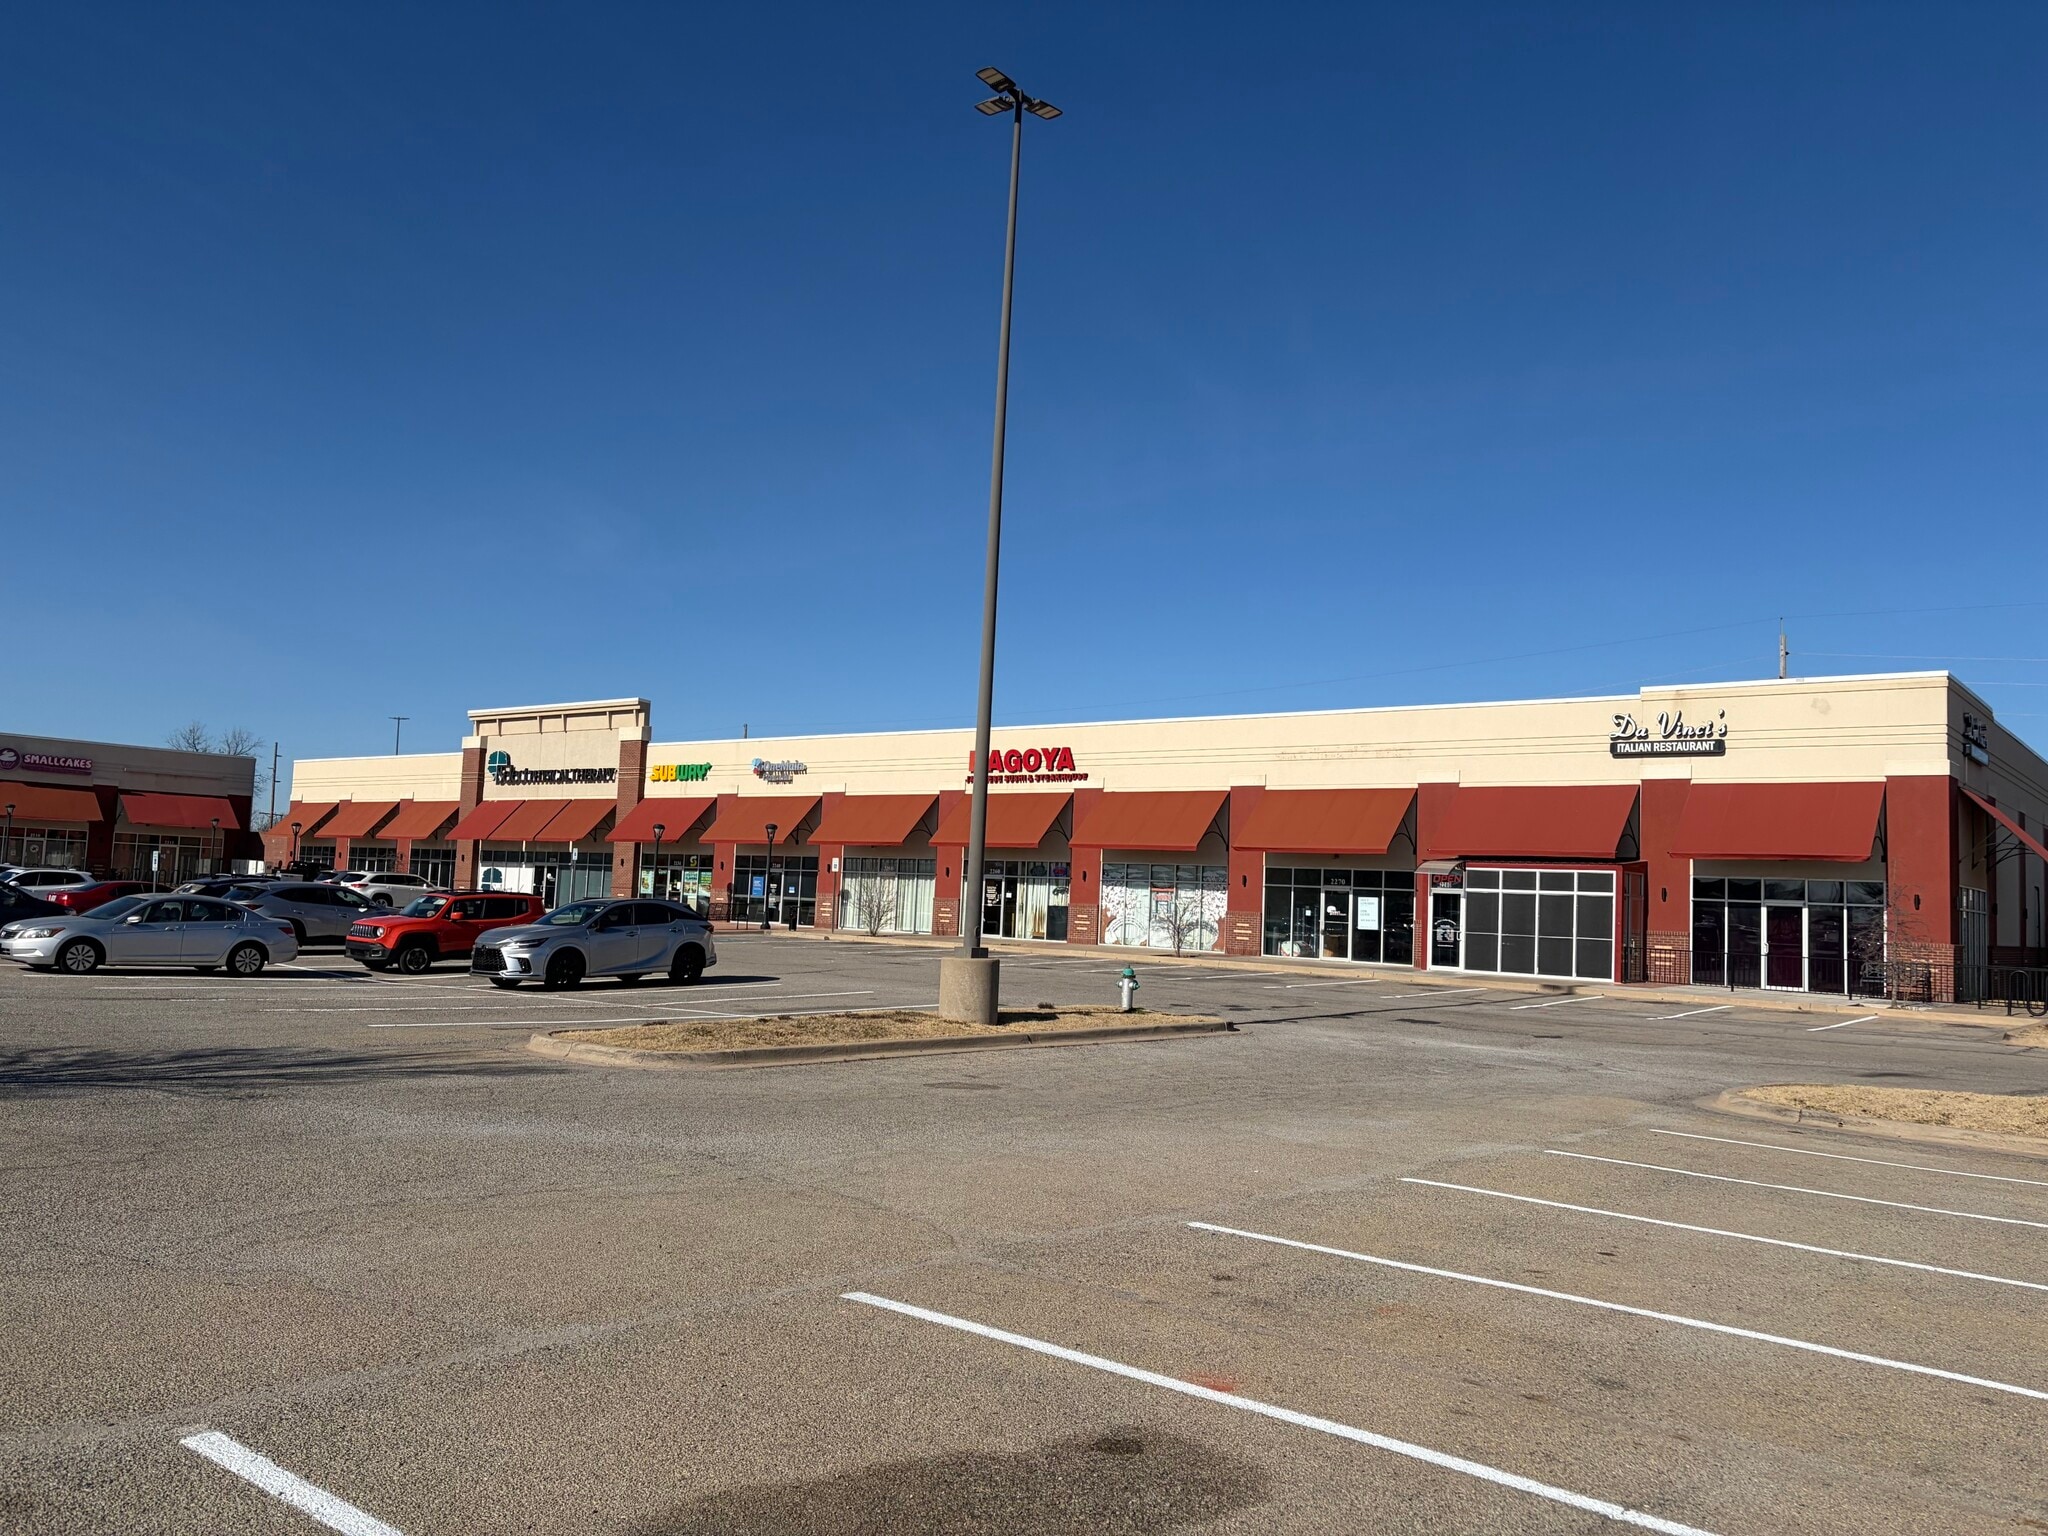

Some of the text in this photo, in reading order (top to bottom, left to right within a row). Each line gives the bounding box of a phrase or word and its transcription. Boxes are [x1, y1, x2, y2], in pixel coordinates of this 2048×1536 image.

[1609, 709, 1727, 741] Da Vinci's
[1616, 741, 1716, 753] ITALIAN RESTAURANT
[24, 754, 92, 769] SMALLCAKES
[650, 762, 712, 782] SUBWAY
[1433, 875, 1462, 883] OPEN
